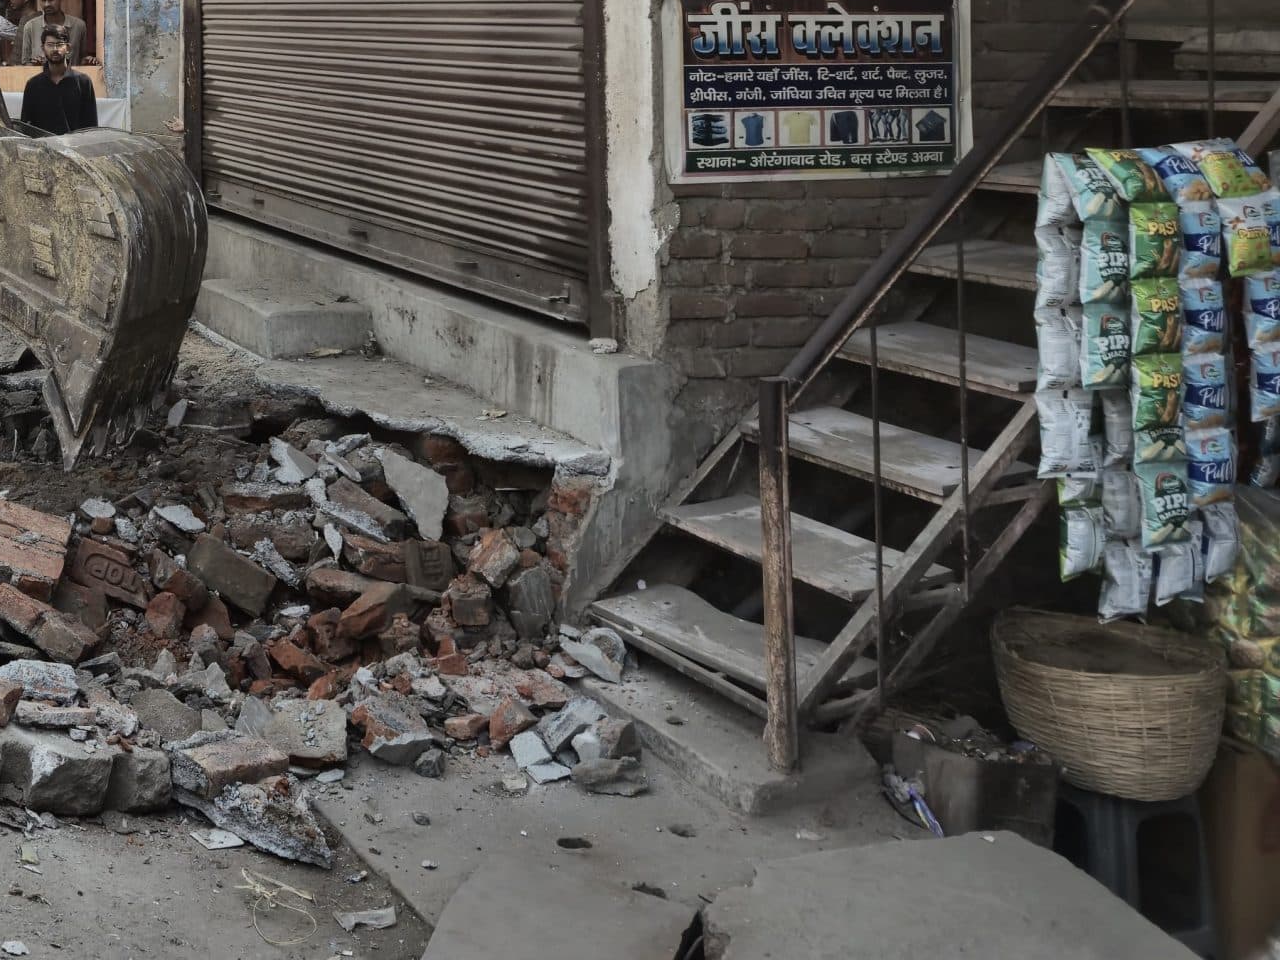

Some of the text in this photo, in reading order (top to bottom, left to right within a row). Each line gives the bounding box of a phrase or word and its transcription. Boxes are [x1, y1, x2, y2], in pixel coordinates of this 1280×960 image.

[687, 1, 782, 55] जींस
[756, 68, 780, 82] यहाँ
[815, 86, 846, 99] उचित
[849, 88, 874, 104] मूल्य
[877, 88, 893, 99] पर
[895, 85, 930, 99] मिलता
[750, 151, 815, 167] औरंगाबाद
[851, 154, 871, 165] बस
[875, 148, 908, 165] स्टैण्ड
[911, 150, 943, 163] अम्बा
